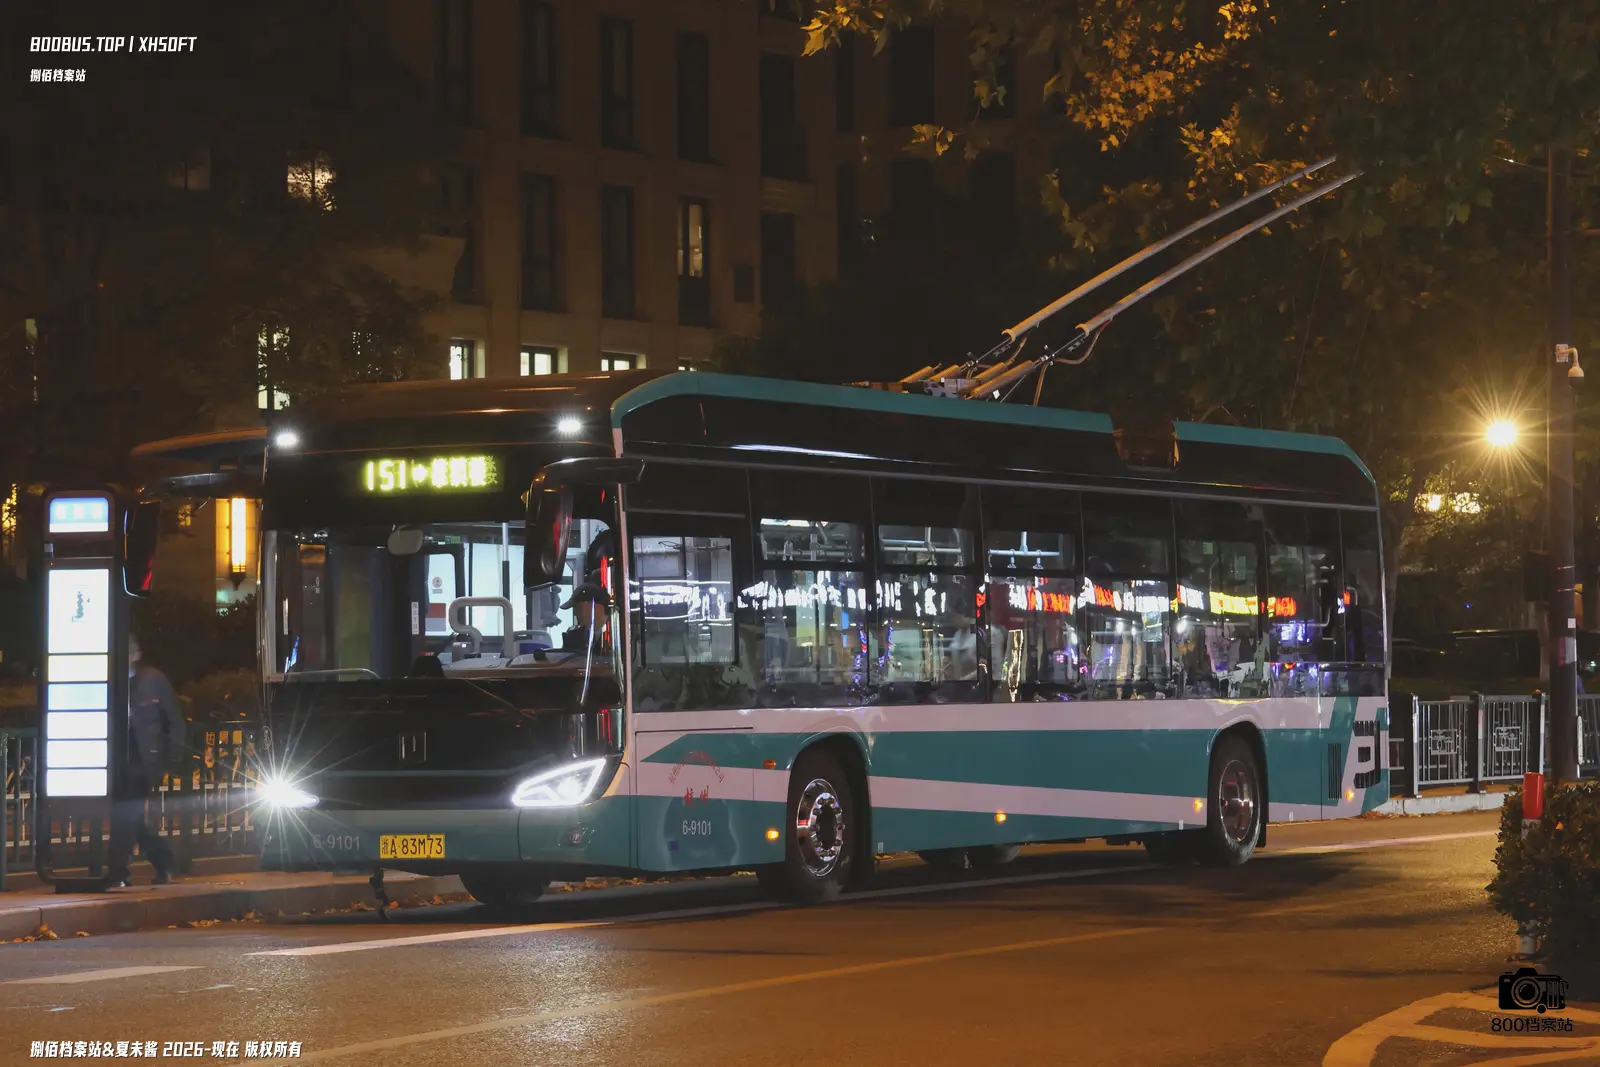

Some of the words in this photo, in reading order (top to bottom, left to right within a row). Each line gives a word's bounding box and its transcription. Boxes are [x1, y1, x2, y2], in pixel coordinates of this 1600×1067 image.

[365, 459, 406, 491] 151
[682, 820, 712, 835] 6-9101
[313, 834, 360, 851] 6-9101
